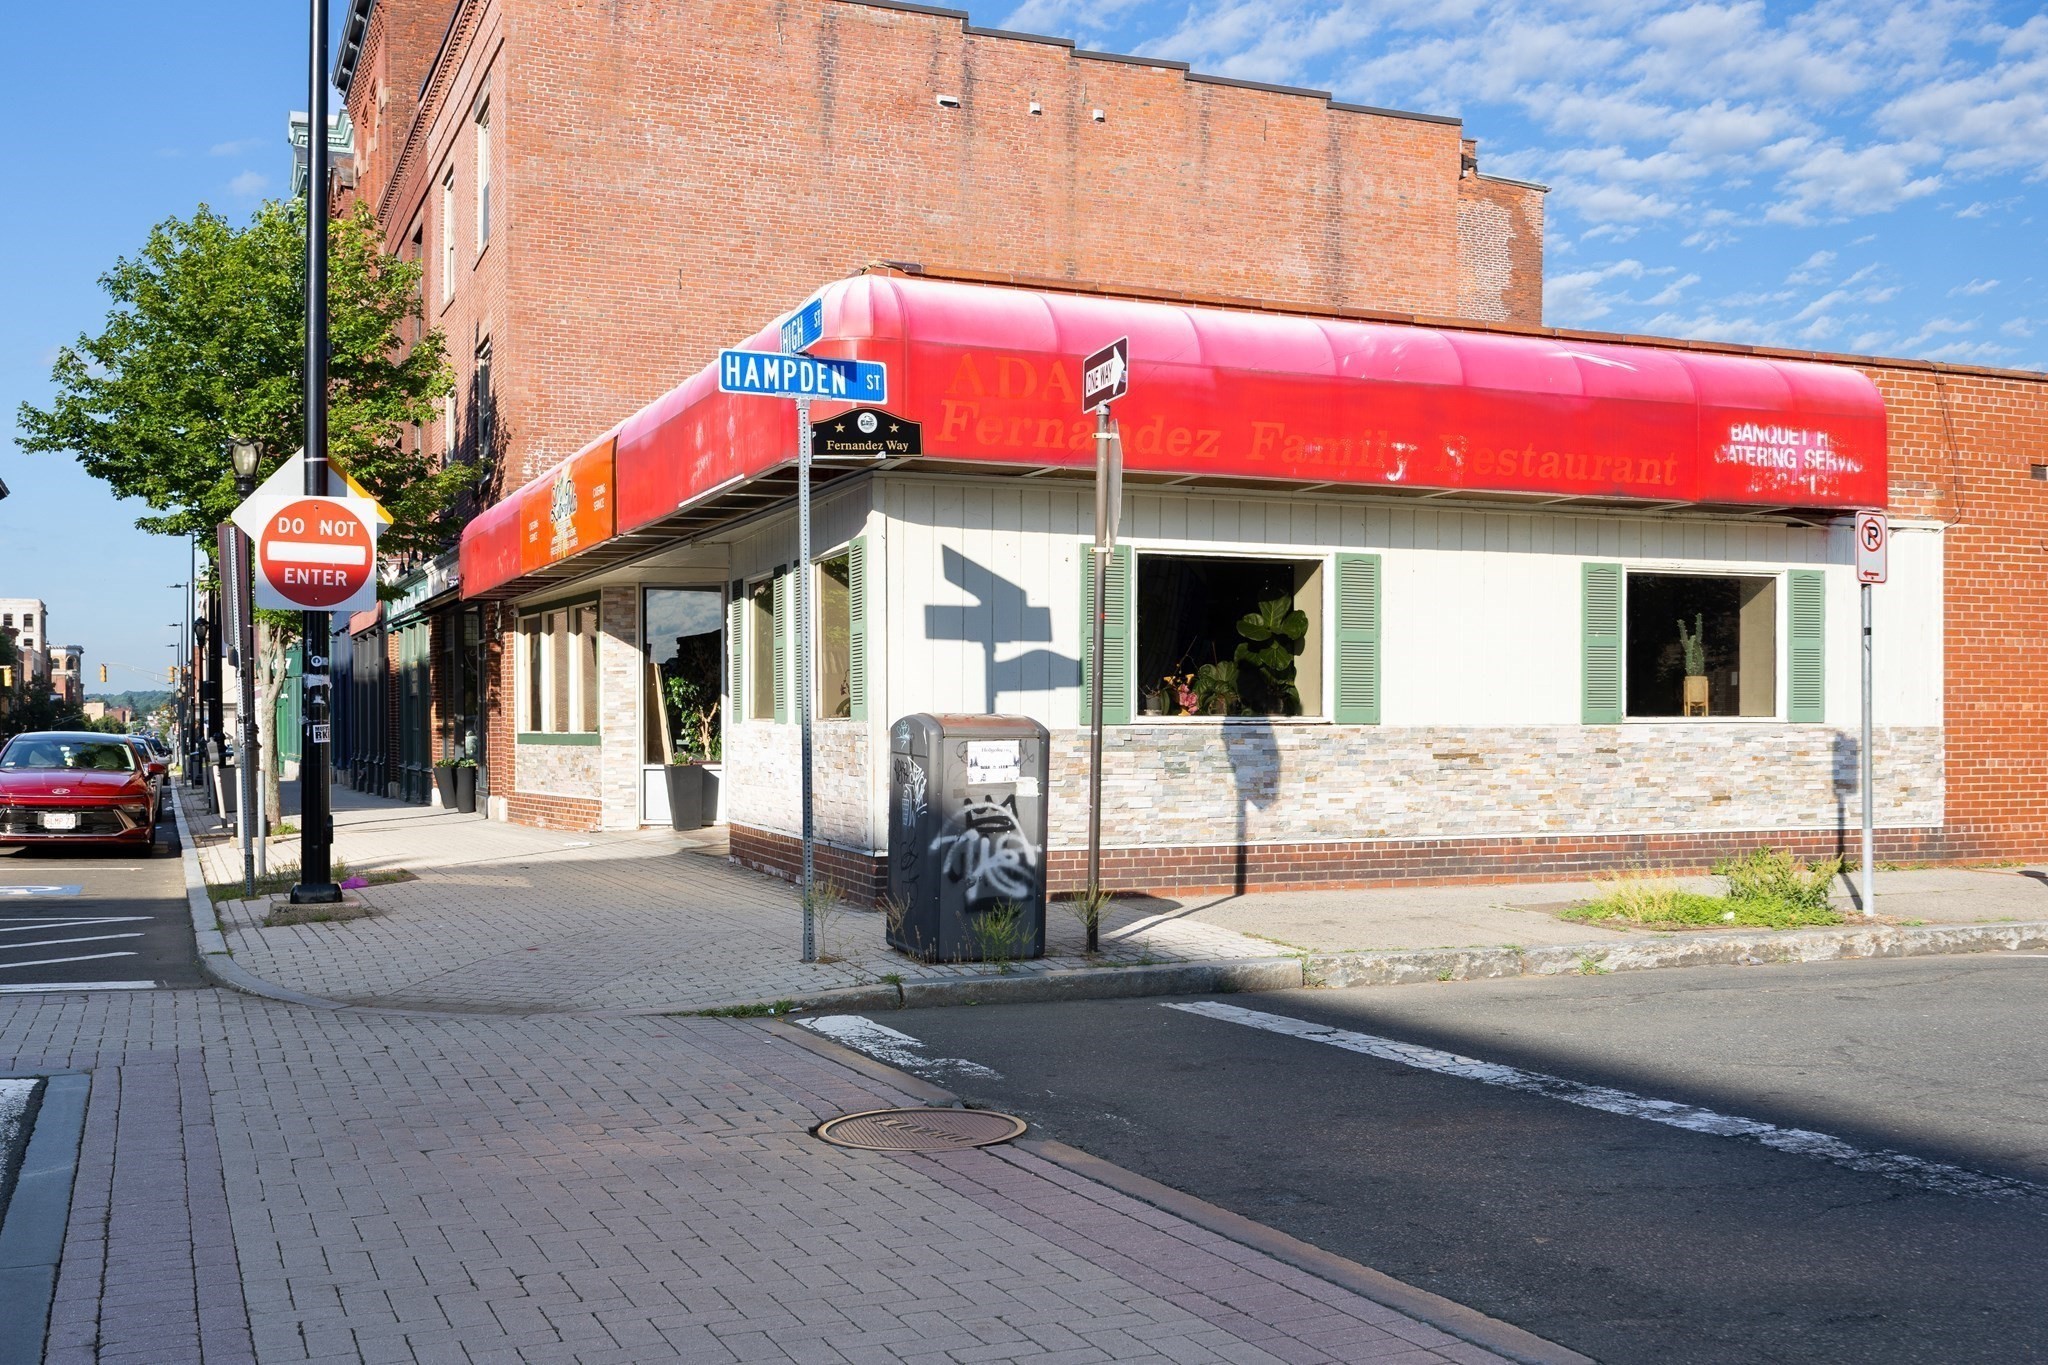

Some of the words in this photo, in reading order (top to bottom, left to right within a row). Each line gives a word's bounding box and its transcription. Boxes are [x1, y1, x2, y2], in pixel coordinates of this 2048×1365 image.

[782, 315, 804, 354] HIGH
[813, 309, 821, 328] ST
[726, 355, 847, 395] HAMPDEN
[866, 374, 881, 391] ST
[945, 352, 1077, 403] ADA
[1088, 369, 1098, 392] ONE
[1100, 361, 1113, 386] WAY
[826, 440, 883, 451] Fernandez
[885, 440, 909, 452] Way
[934, 399, 1223, 459] Fernadez
[1246, 420, 1419, 482] Family
[1434, 433, 1680, 487] Restaurant
[1730, 422, 1807, 446] BANQUET
[278, 517, 305, 534] DO
[319, 519, 357, 537] NOT
[284, 568, 347, 587] ENTER
